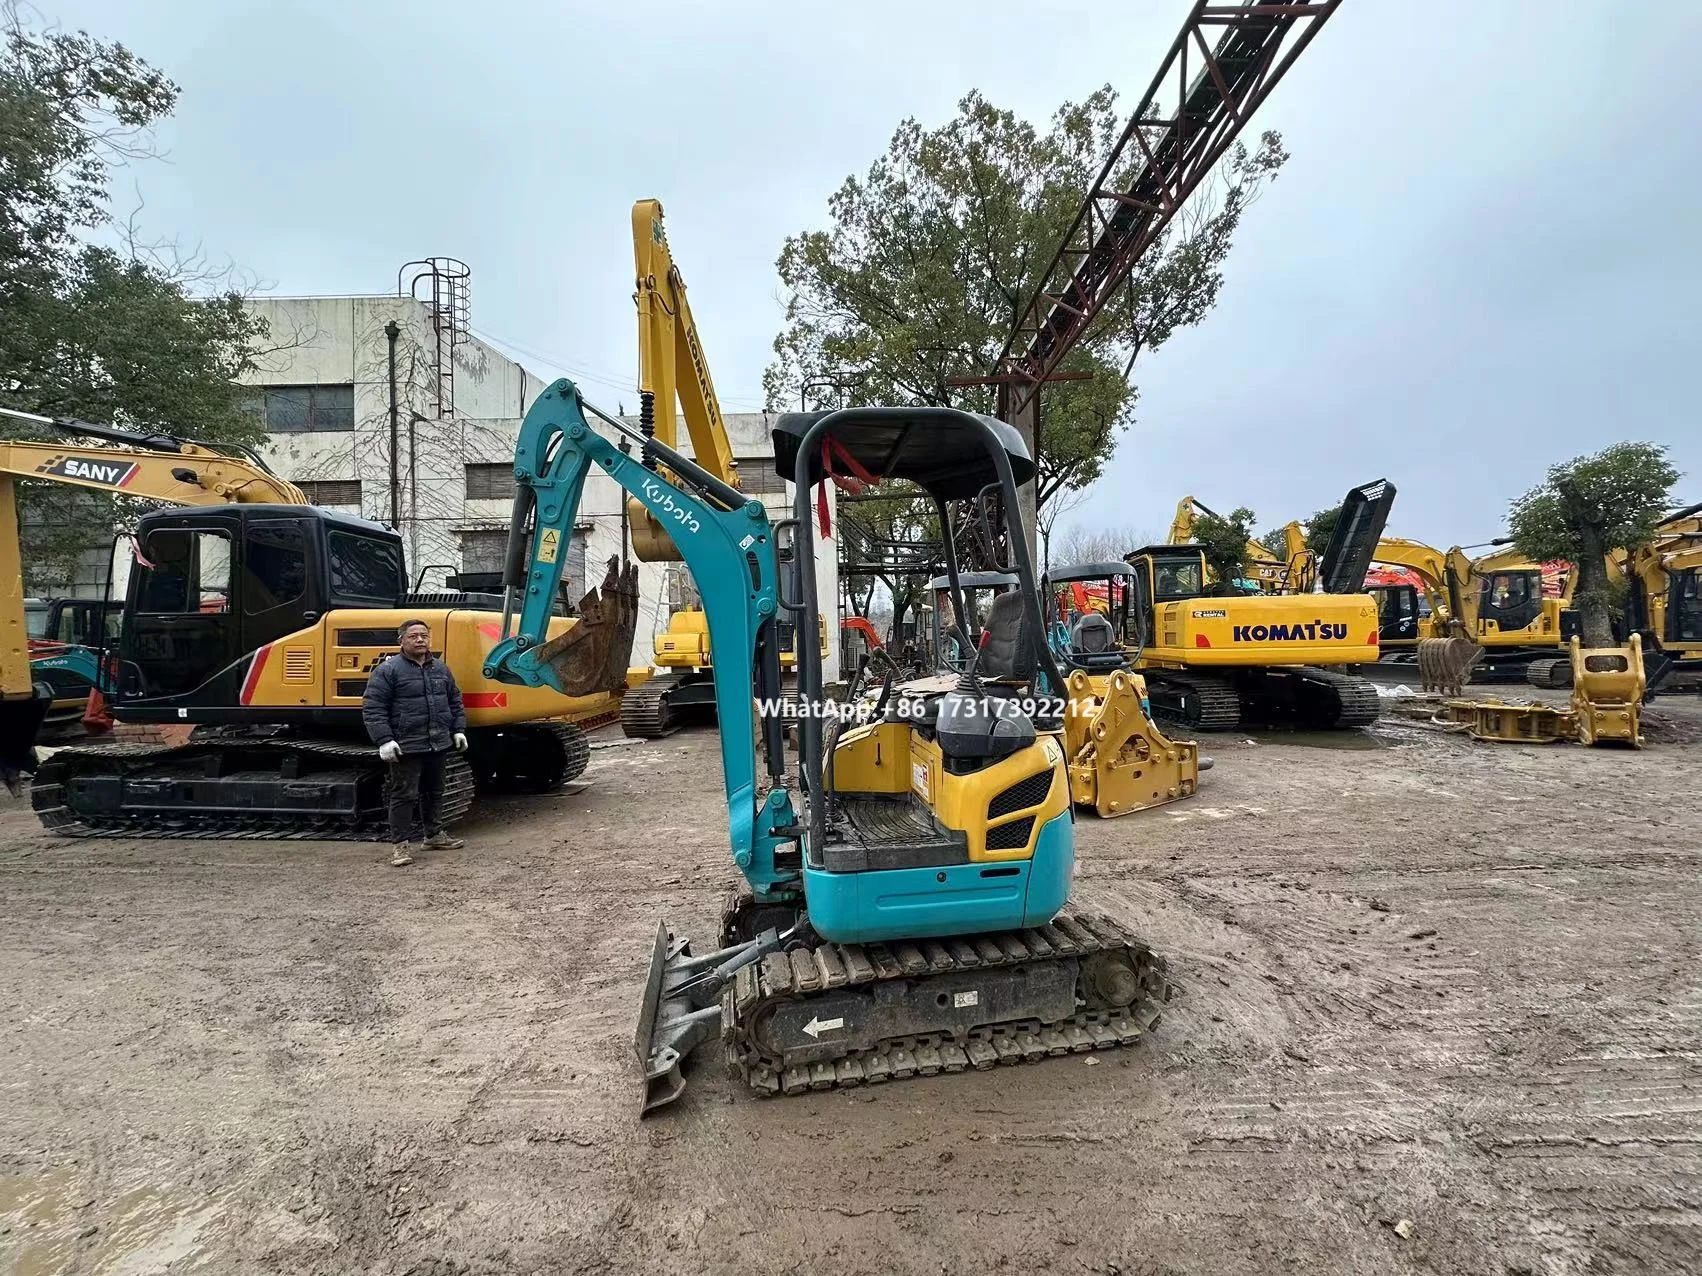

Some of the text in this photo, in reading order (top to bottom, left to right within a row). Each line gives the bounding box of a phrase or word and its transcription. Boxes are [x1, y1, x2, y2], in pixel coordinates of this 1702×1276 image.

[686, 326, 717, 427] KOMATSU
[64, 460, 119, 482] SANY
[641, 478, 700, 533] Kubota
[1259, 568, 1273, 577] CAT
[1233, 619, 1347, 642] KOMATSU
